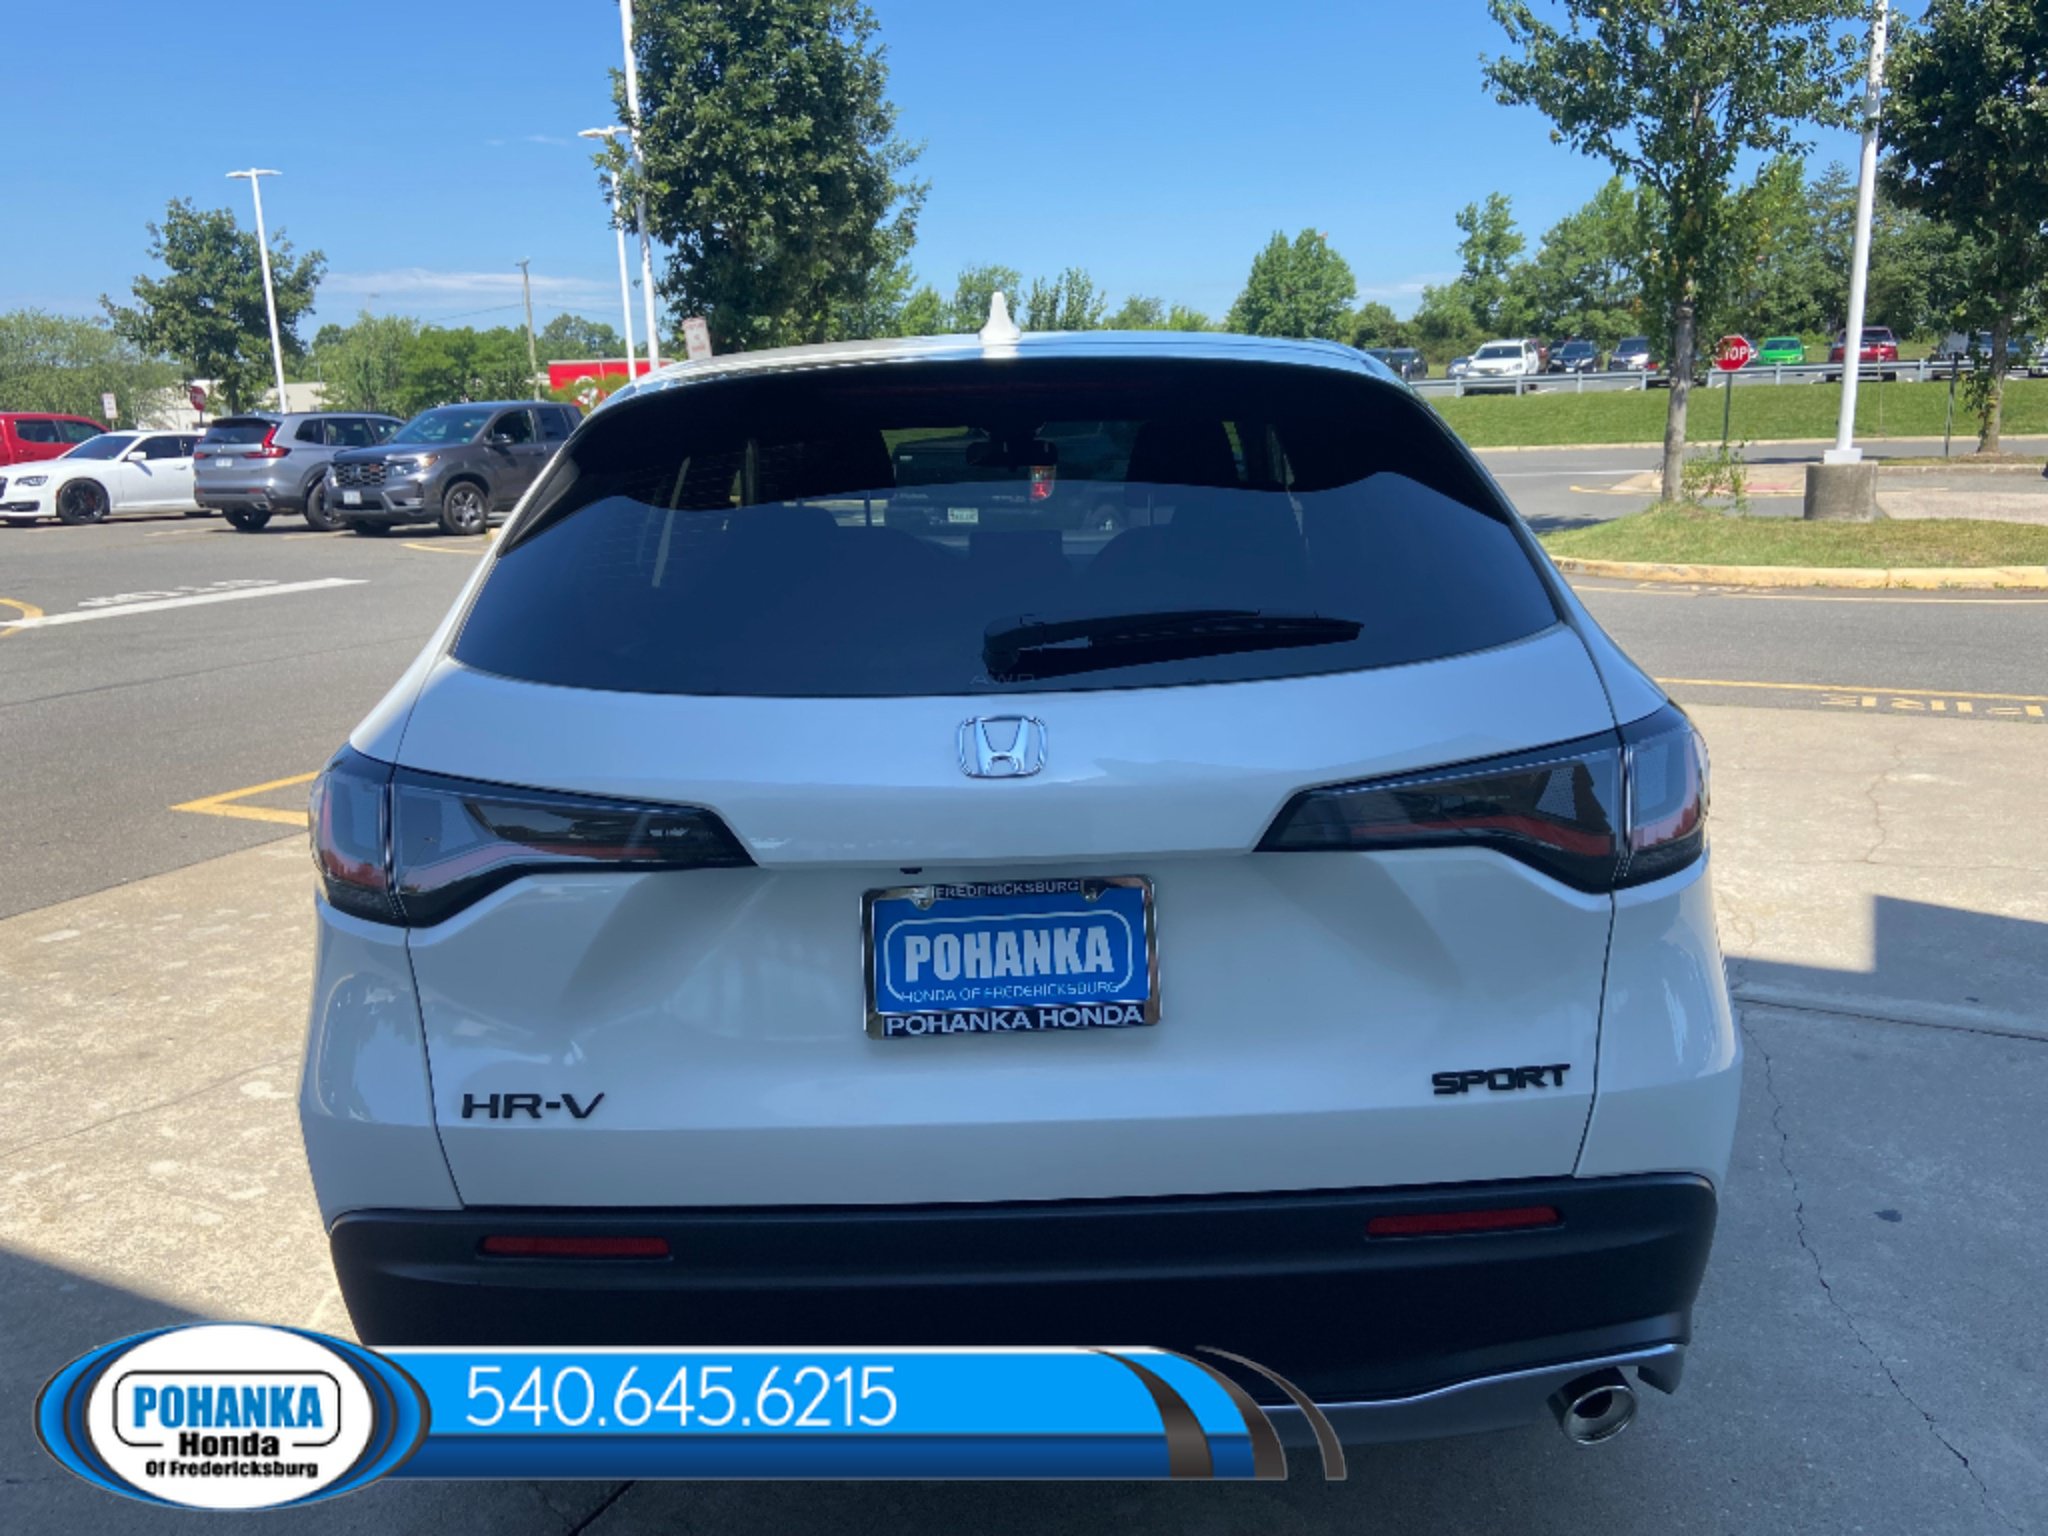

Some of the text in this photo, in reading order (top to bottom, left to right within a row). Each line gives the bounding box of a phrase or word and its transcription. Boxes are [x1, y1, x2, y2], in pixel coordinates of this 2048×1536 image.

[935, 880, 1080, 898] FREDERICKSBURG
[904, 926, 1115, 983] POHANKA
[900, 980, 1119, 1003] HONDA OF FREDERICKSBURG
[885, 1005, 1145, 1036] POHANKA HONDA
[1431, 1063, 1571, 1096] SPORT
[461, 1092, 605, 1119] HR-V
